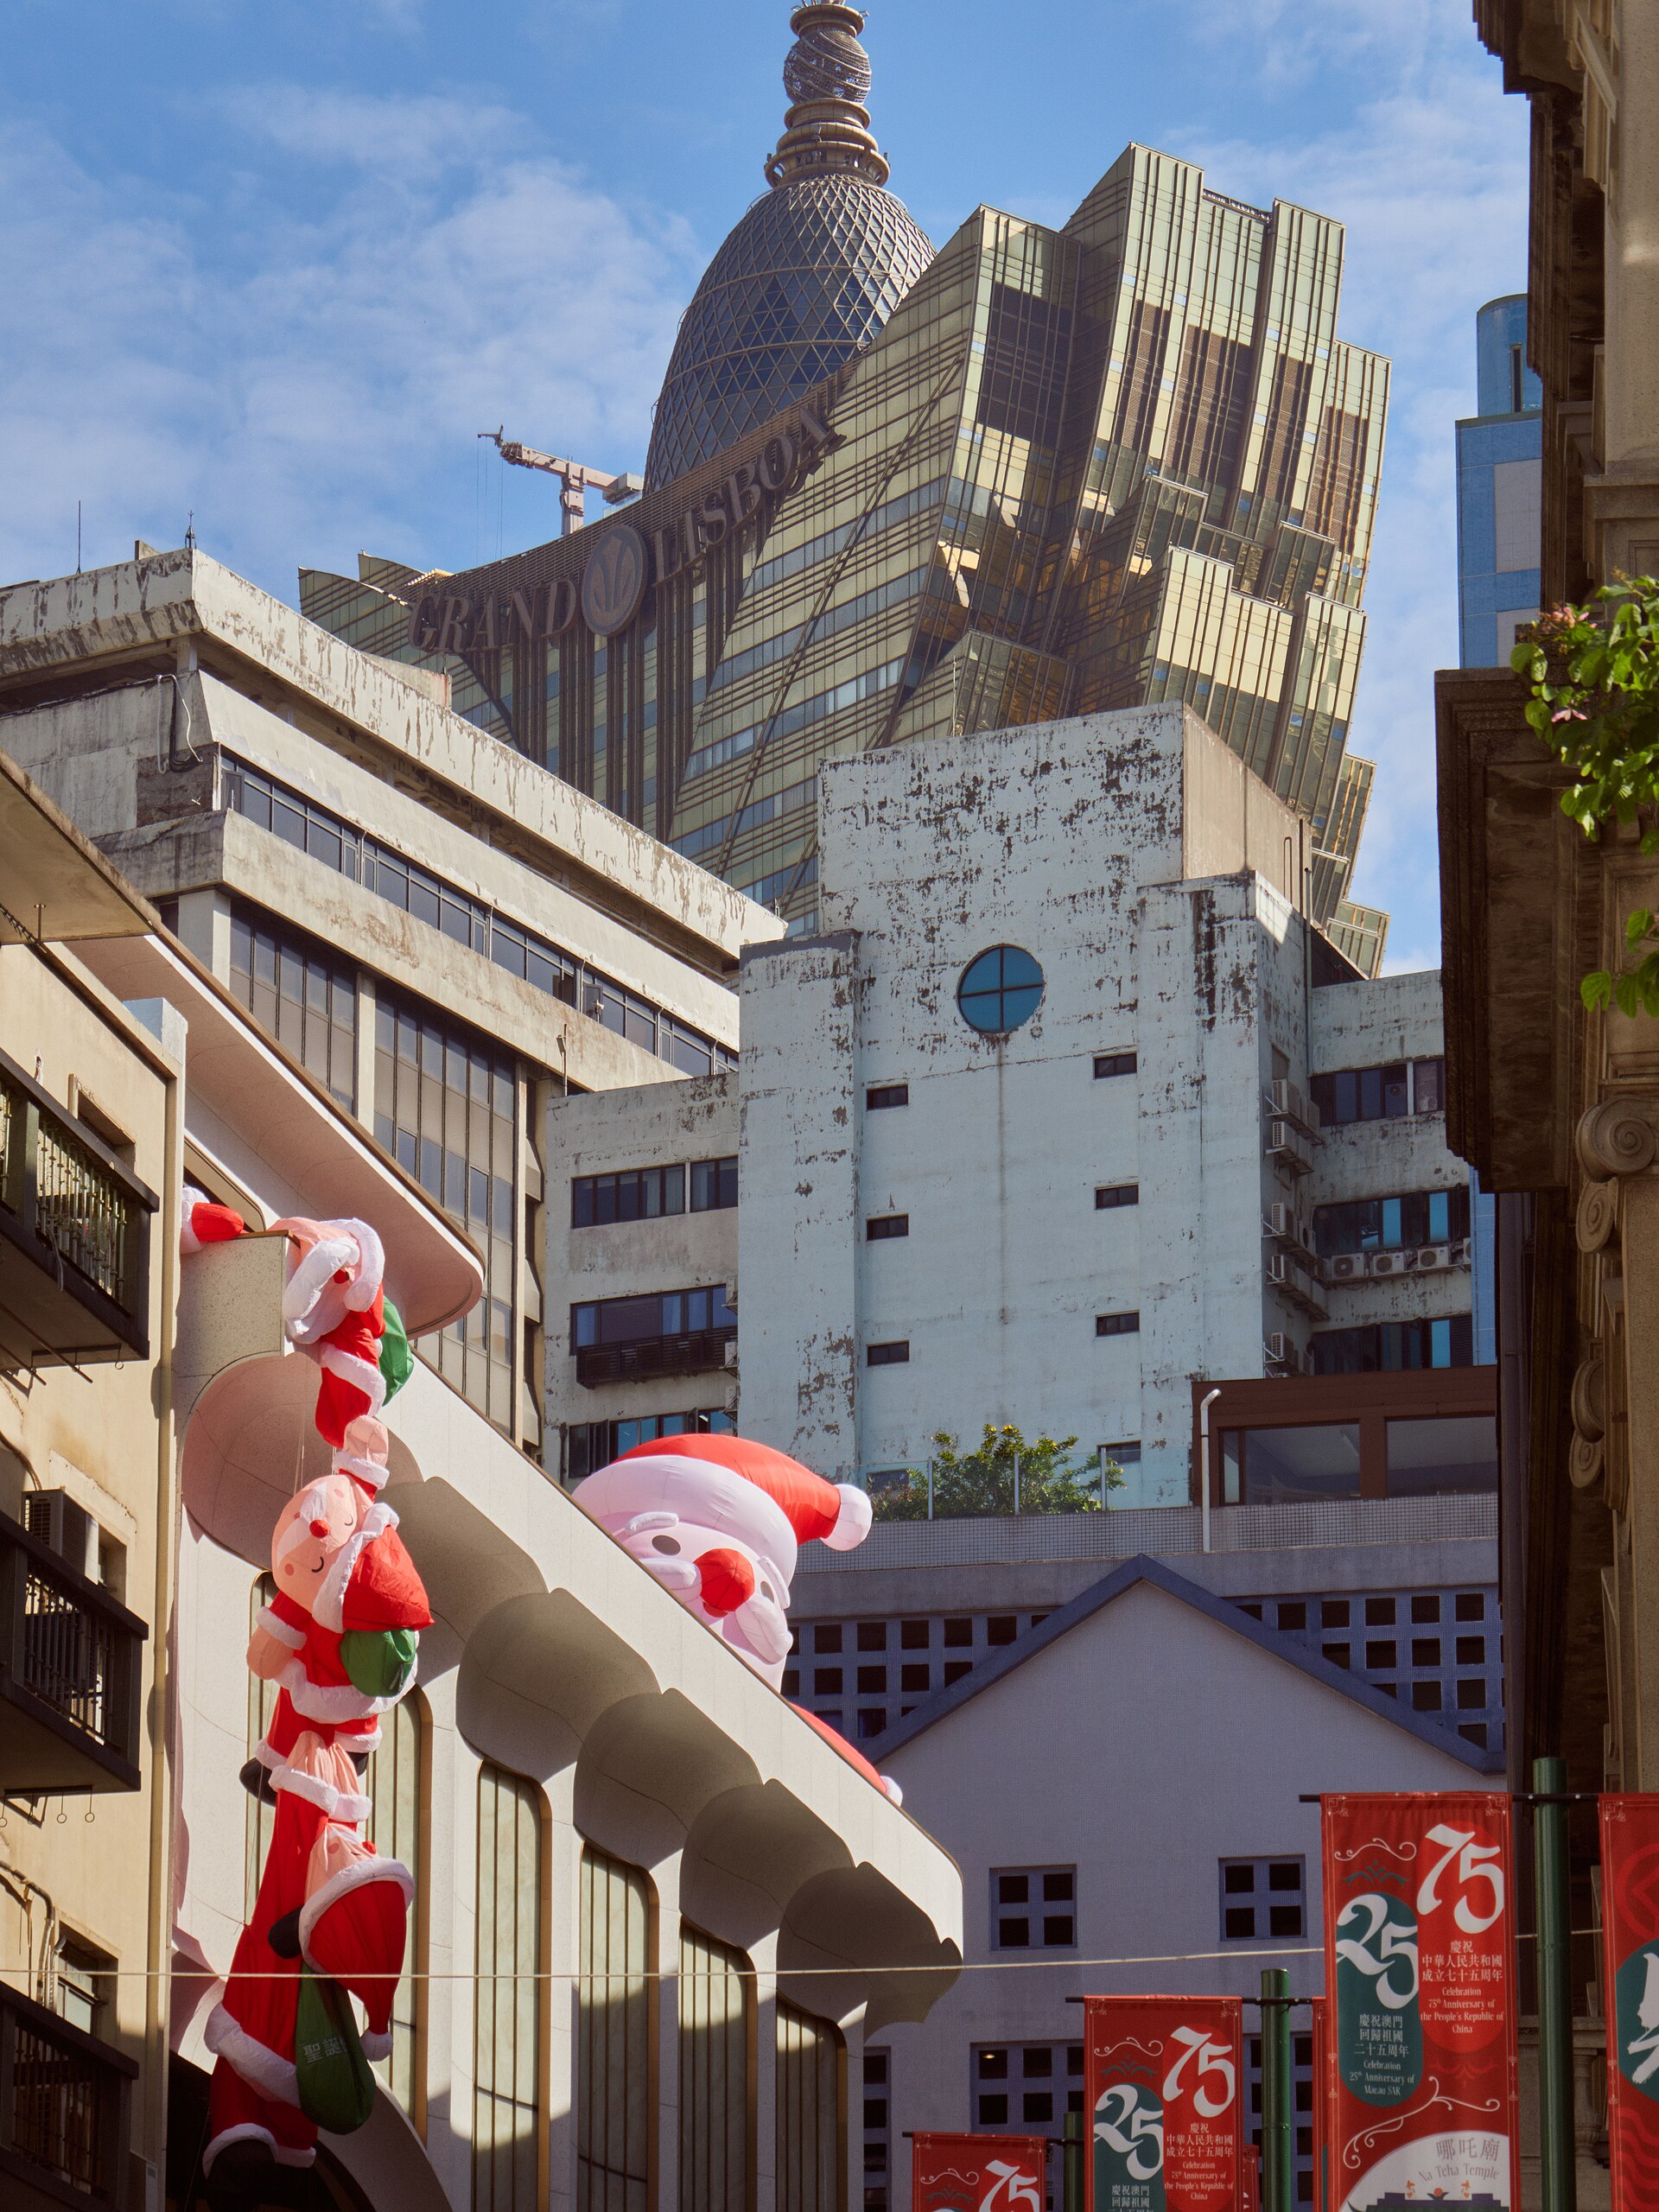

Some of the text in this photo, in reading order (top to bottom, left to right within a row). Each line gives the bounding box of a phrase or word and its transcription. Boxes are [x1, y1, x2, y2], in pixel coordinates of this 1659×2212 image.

[407, 406, 847, 653] GRAND LISBOA
[1417, 1824, 1504, 1934] 75
[1336, 1894, 1419, 2010] 25
[1450, 1941, 1474, 1954] 慶祝
[1421, 1955, 1503, 1968] 中華人民共和國
[1421, 1969, 1503, 1983] 成立七十五周年
[1442, 1986, 1482, 1997] Celebration
[1442, 1999, 1484, 2012] Anniversary
[1487, 1999, 1496, 2010] of
[1359, 2014, 1403, 2028] 慶祝澳門
[1421, 2012, 1504, 2024] the People's Republic of
[1452, 2024, 1473, 2034] China
[1359, 2028, 1403, 2043] 回歸祖國
[1354, 2043, 1409, 2058] 二十五周年
[1162, 2025, 1235, 2117] 75
[1363, 2060, 1402, 2070] Celebration
[1365, 2073, 1405, 2084] Anniversary
[1407, 2074, 1415, 2083] of
[1364, 2085, 1401, 2096] Macau SAR
[1094, 2084, 1164, 2180] 25
[1190, 2122, 1209, 2133] 慶祝
[1166, 2134, 1234, 2145] 中華人民共和國
[1166, 2146, 1234, 2157] 成立七十五周年
[1182, 2161, 1216, 2170] Celebration
[1183, 2171, 1218, 2182] Anniversary
[1219, 2171, 1227, 2180] of
[1463, 2163, 1499, 2181] Temple
[978, 2159, 1039, 2212] 75
[1112, 2184, 1150, 2196] 慶祝澳門
[1176, 2182, 1199, 2191] People's
[1200, 2182, 1225, 2190] Republic
[1112, 2196, 1150, 2208] 回歸祖國
